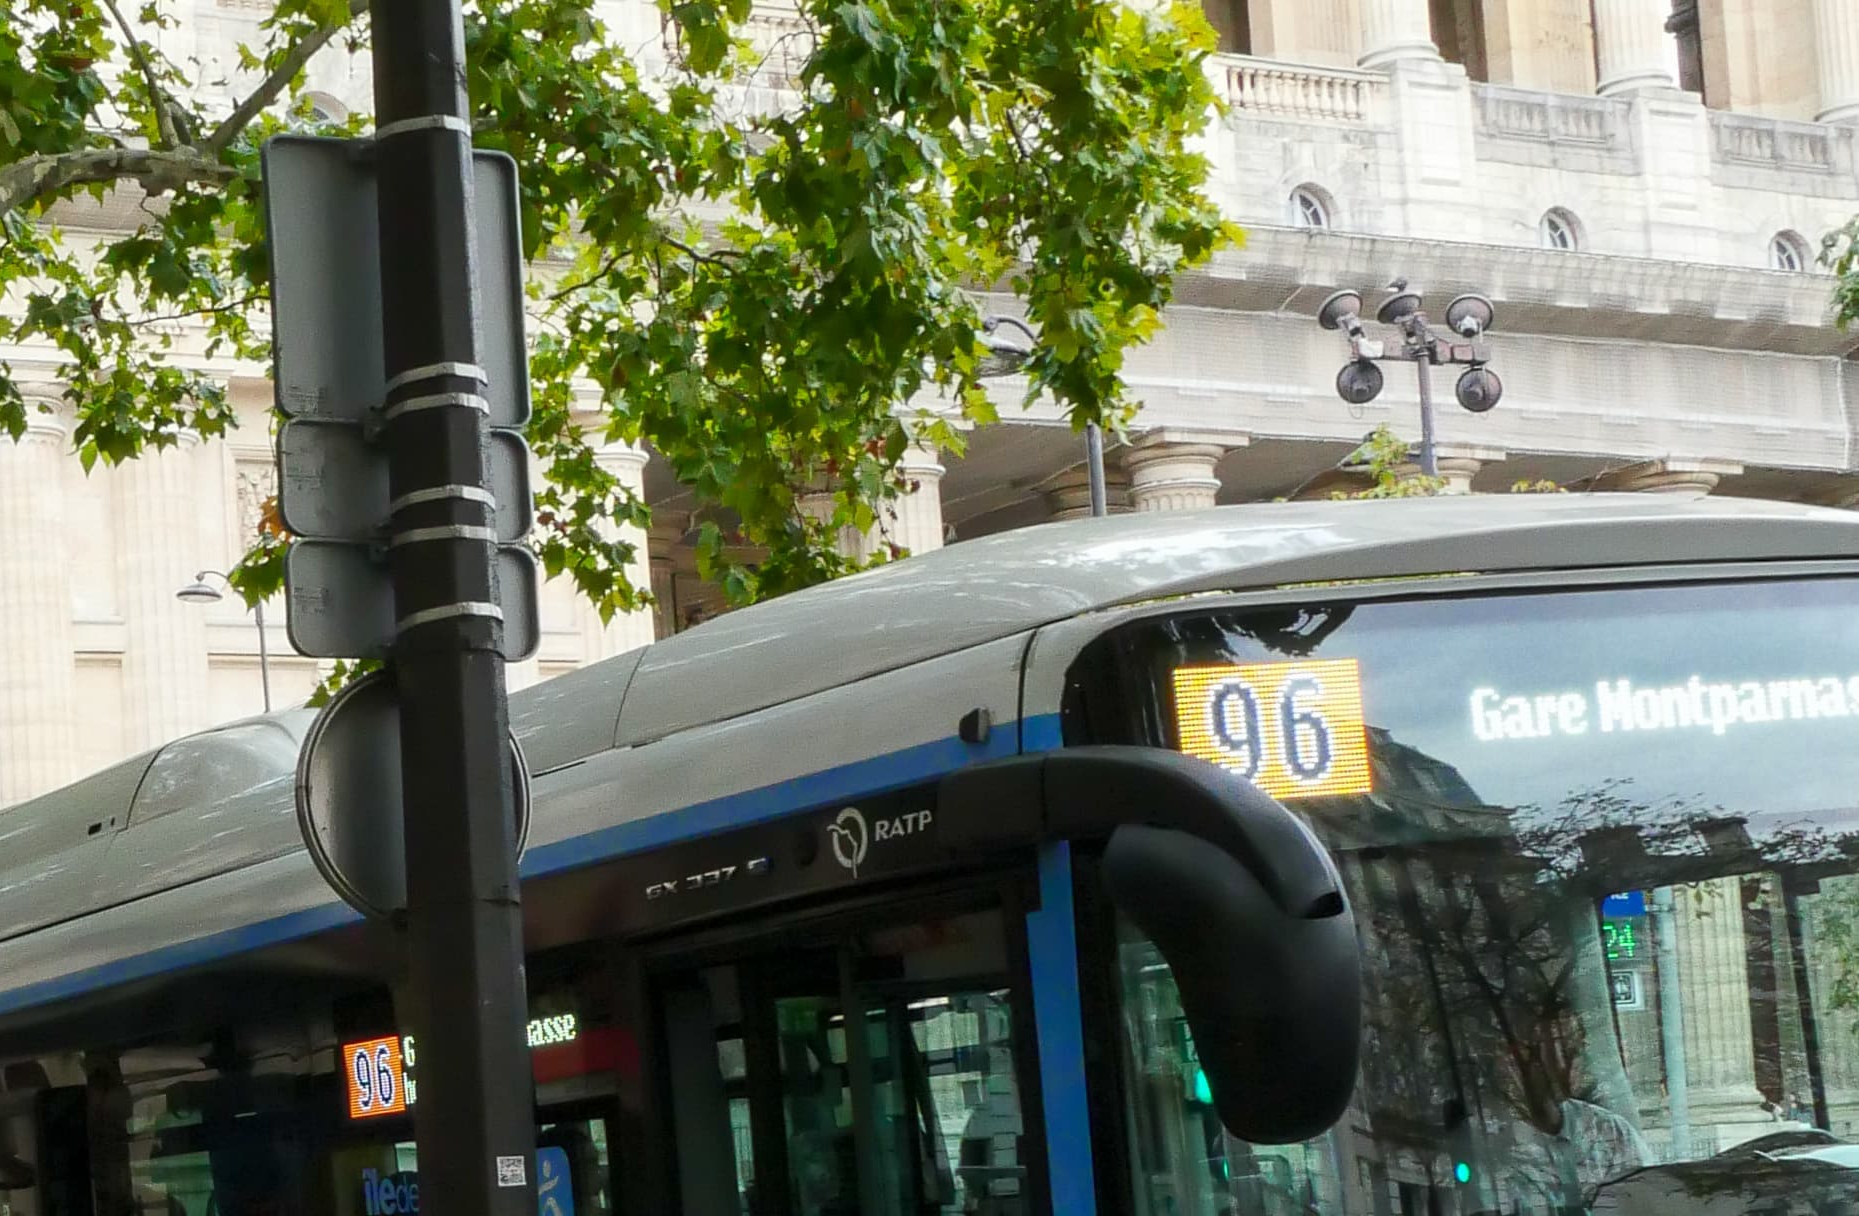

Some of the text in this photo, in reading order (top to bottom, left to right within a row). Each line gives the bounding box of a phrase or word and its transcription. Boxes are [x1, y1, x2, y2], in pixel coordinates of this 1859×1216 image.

[1207, 671, 1332, 786] 96
[1470, 687, 1588, 740] Gare
[874, 810, 933, 842] RATP
[645, 881, 678, 901] GX
[685, 865, 737, 890] 337
[353, 1043, 397, 1112] 96
